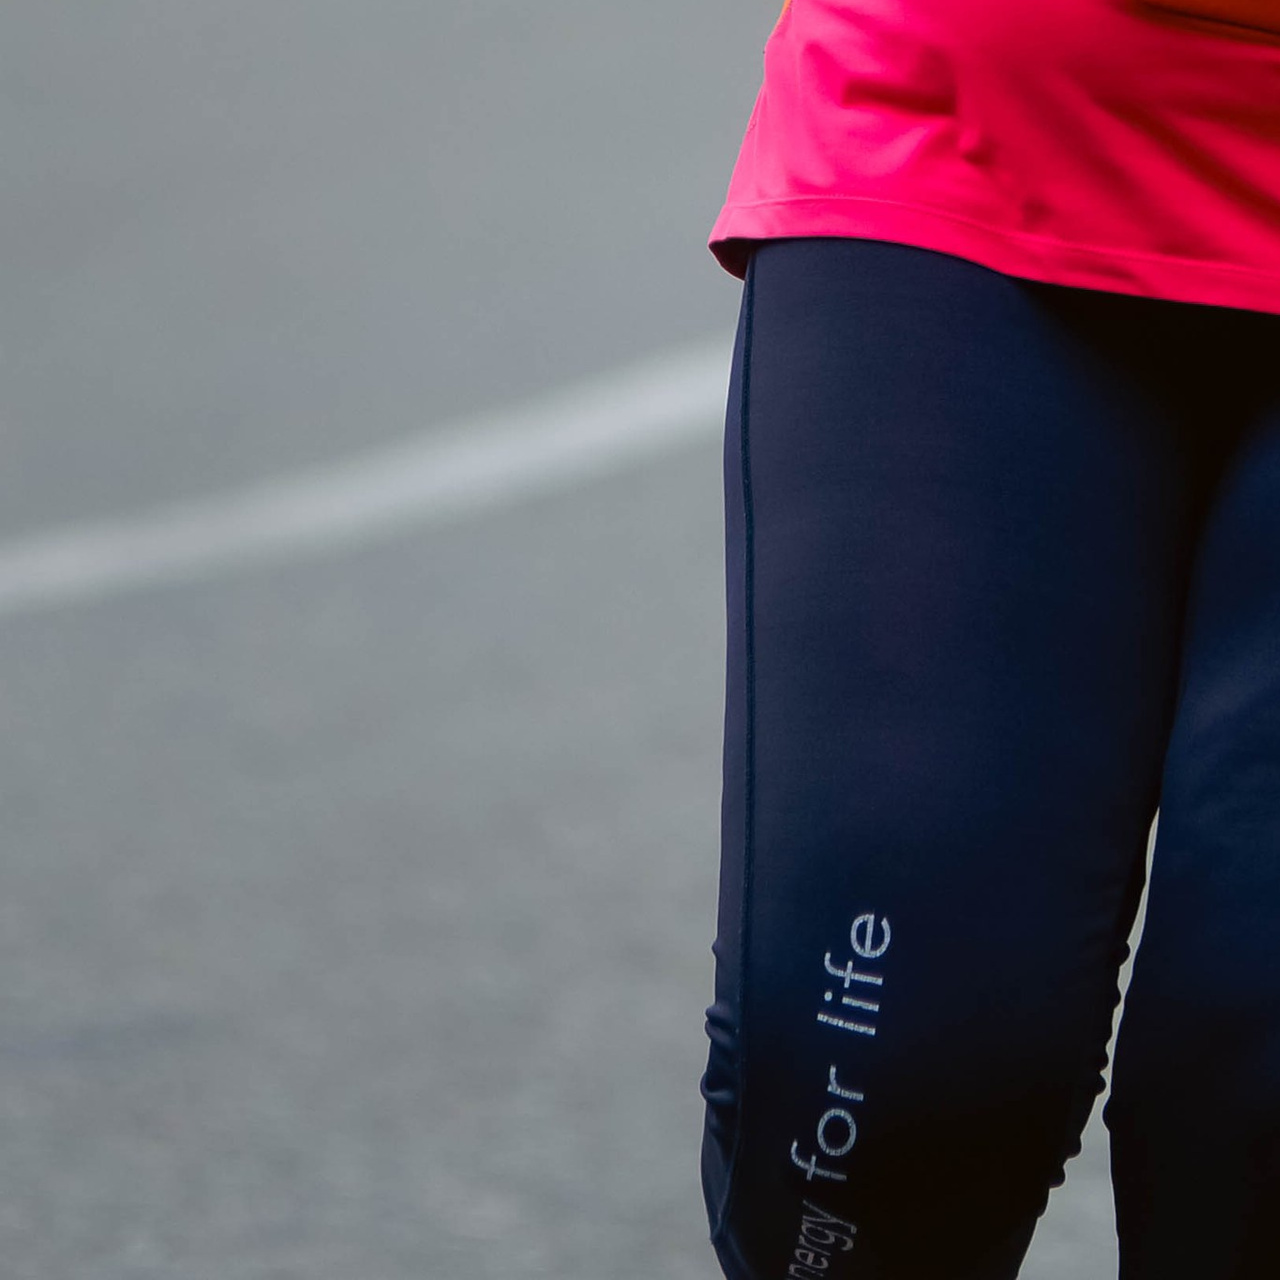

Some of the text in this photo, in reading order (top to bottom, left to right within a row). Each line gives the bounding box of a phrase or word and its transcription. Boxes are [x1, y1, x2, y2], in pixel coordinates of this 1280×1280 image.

[785, 913, 891, 1280] nergy for life
